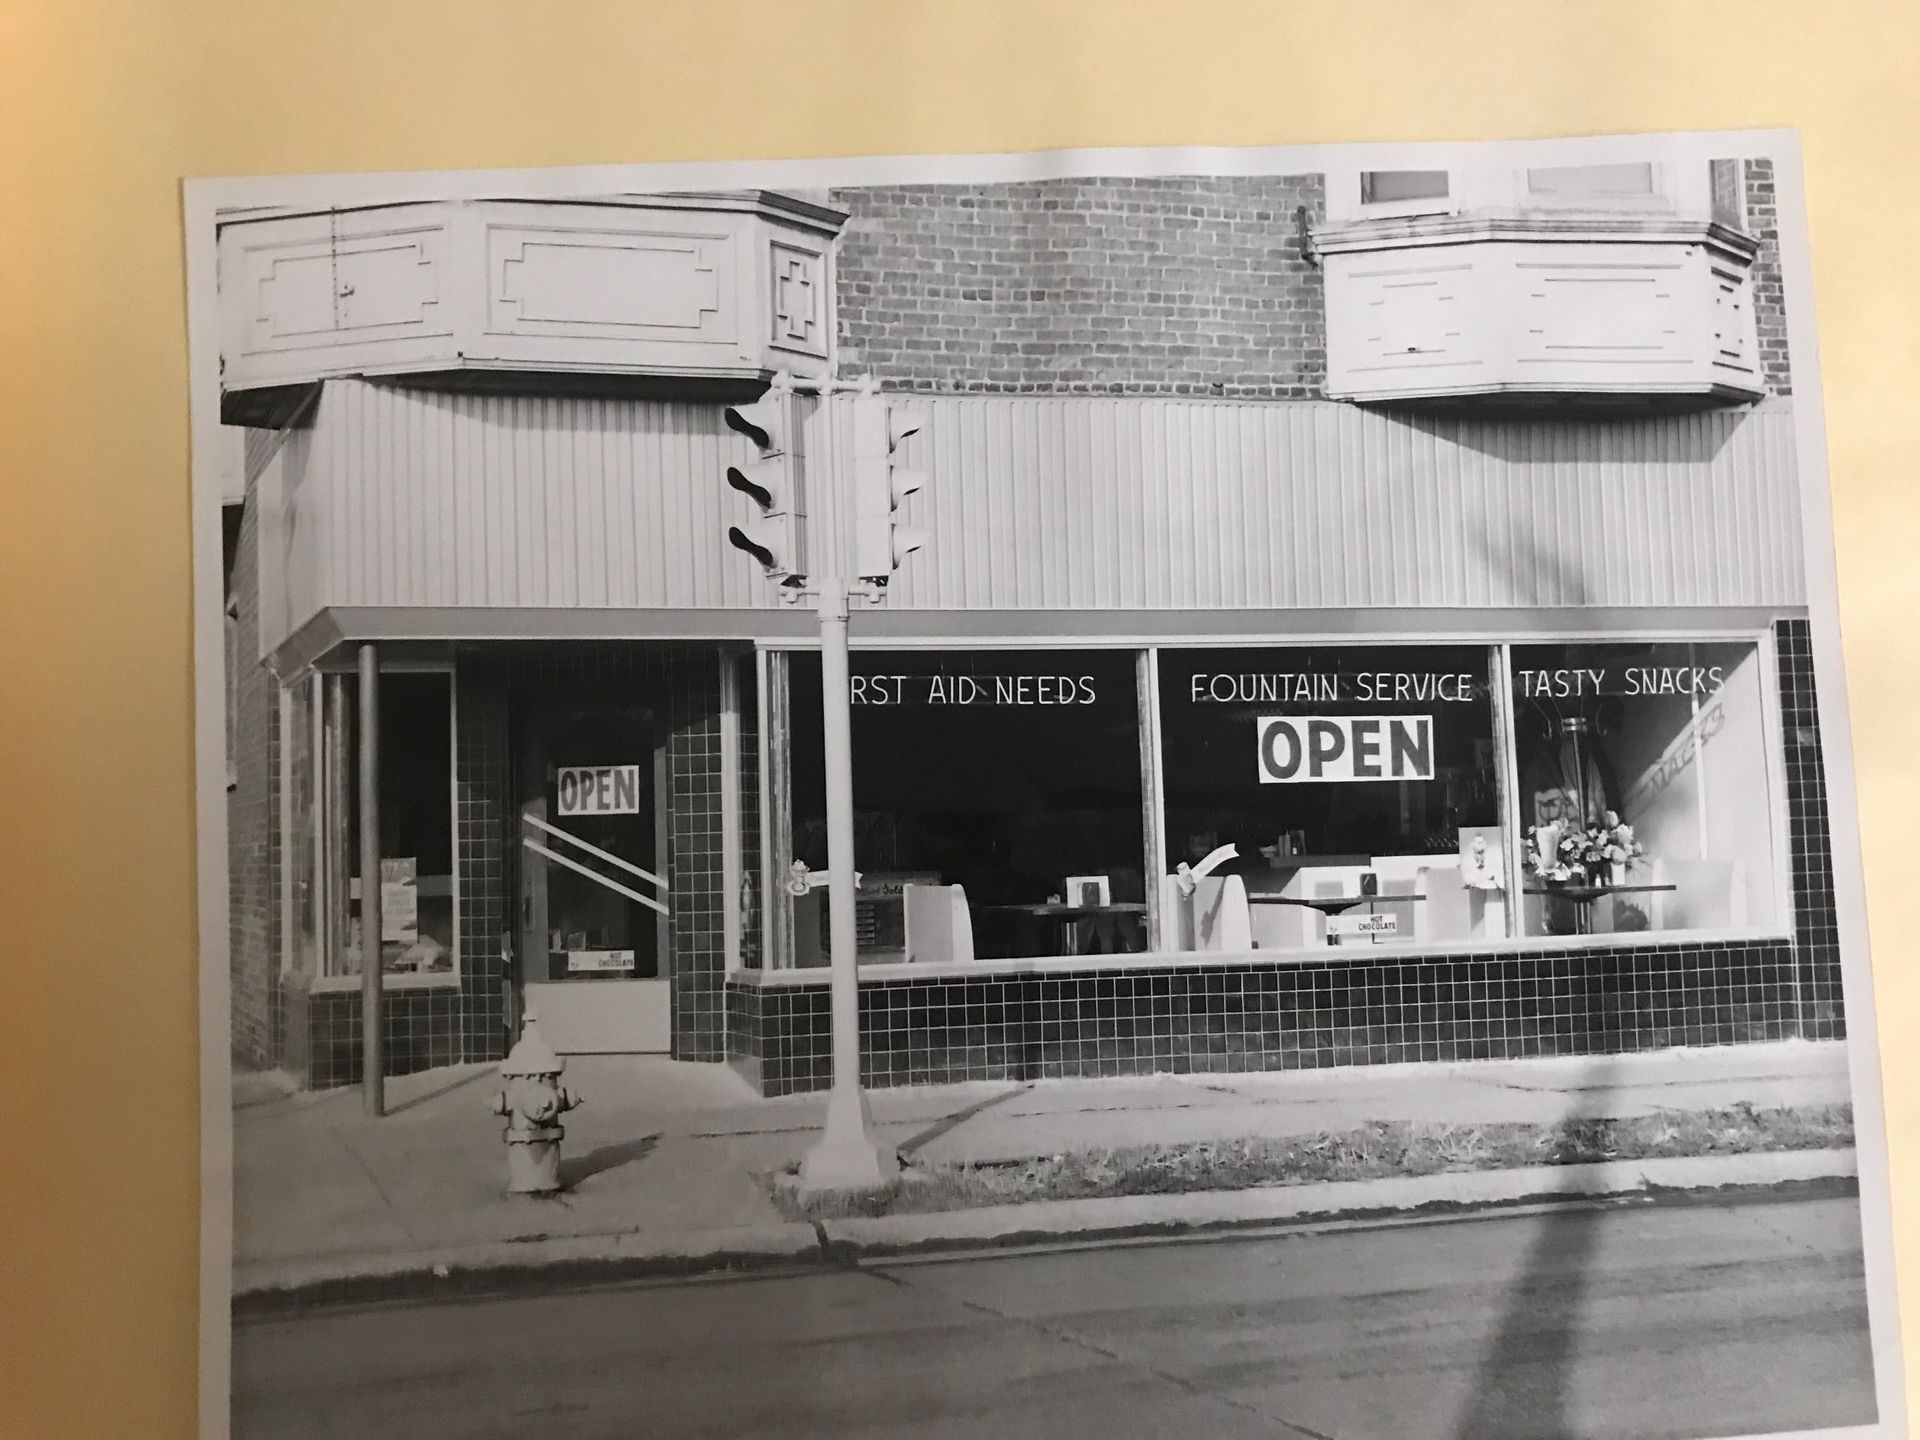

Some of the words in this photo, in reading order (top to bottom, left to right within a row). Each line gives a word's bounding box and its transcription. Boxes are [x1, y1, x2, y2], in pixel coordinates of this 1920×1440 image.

[851, 675, 907, 704] RST
[928, 675, 976, 704] AID
[996, 676, 1096, 704] NEEDS
[1191, 673, 1338, 702] FOUNTAIN
[1356, 672, 1473, 701] SERVICE
[1519, 669, 1606, 697] TASTY
[1624, 667, 1725, 695] SNACKS
[1261, 719, 1431, 779] OPEN
[560, 769, 635, 811] OPEN
[1358, 922, 1396, 931] CHOCOLATE
[1370, 915, 1383, 923] HOT
[599, 959, 634, 968] CHOCOLATE
